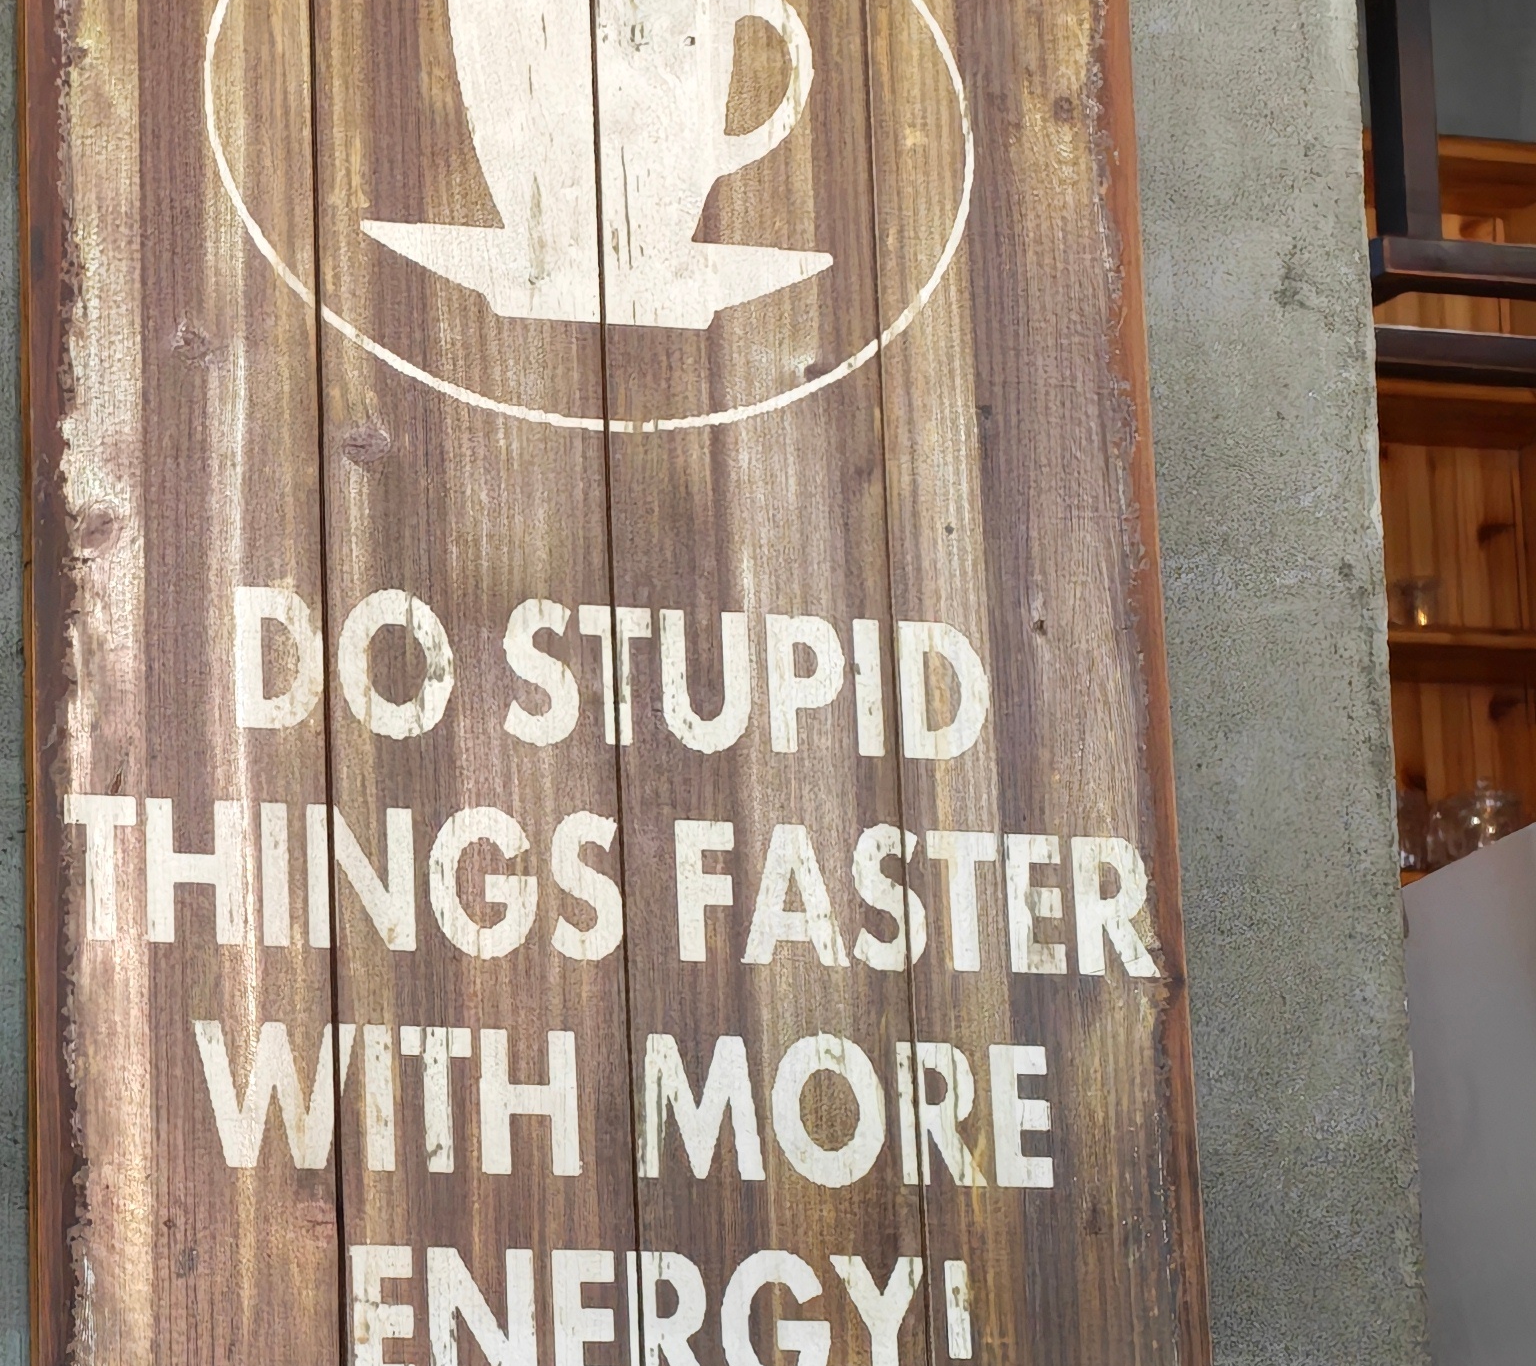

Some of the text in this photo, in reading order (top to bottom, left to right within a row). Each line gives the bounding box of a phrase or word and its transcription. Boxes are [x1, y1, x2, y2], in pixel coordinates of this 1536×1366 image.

[232, 585, 990, 762] DO STUPID
[63, 793, 1161, 979] THINGS FASTER
[193, 1020, 1056, 1189] WITH MORE
